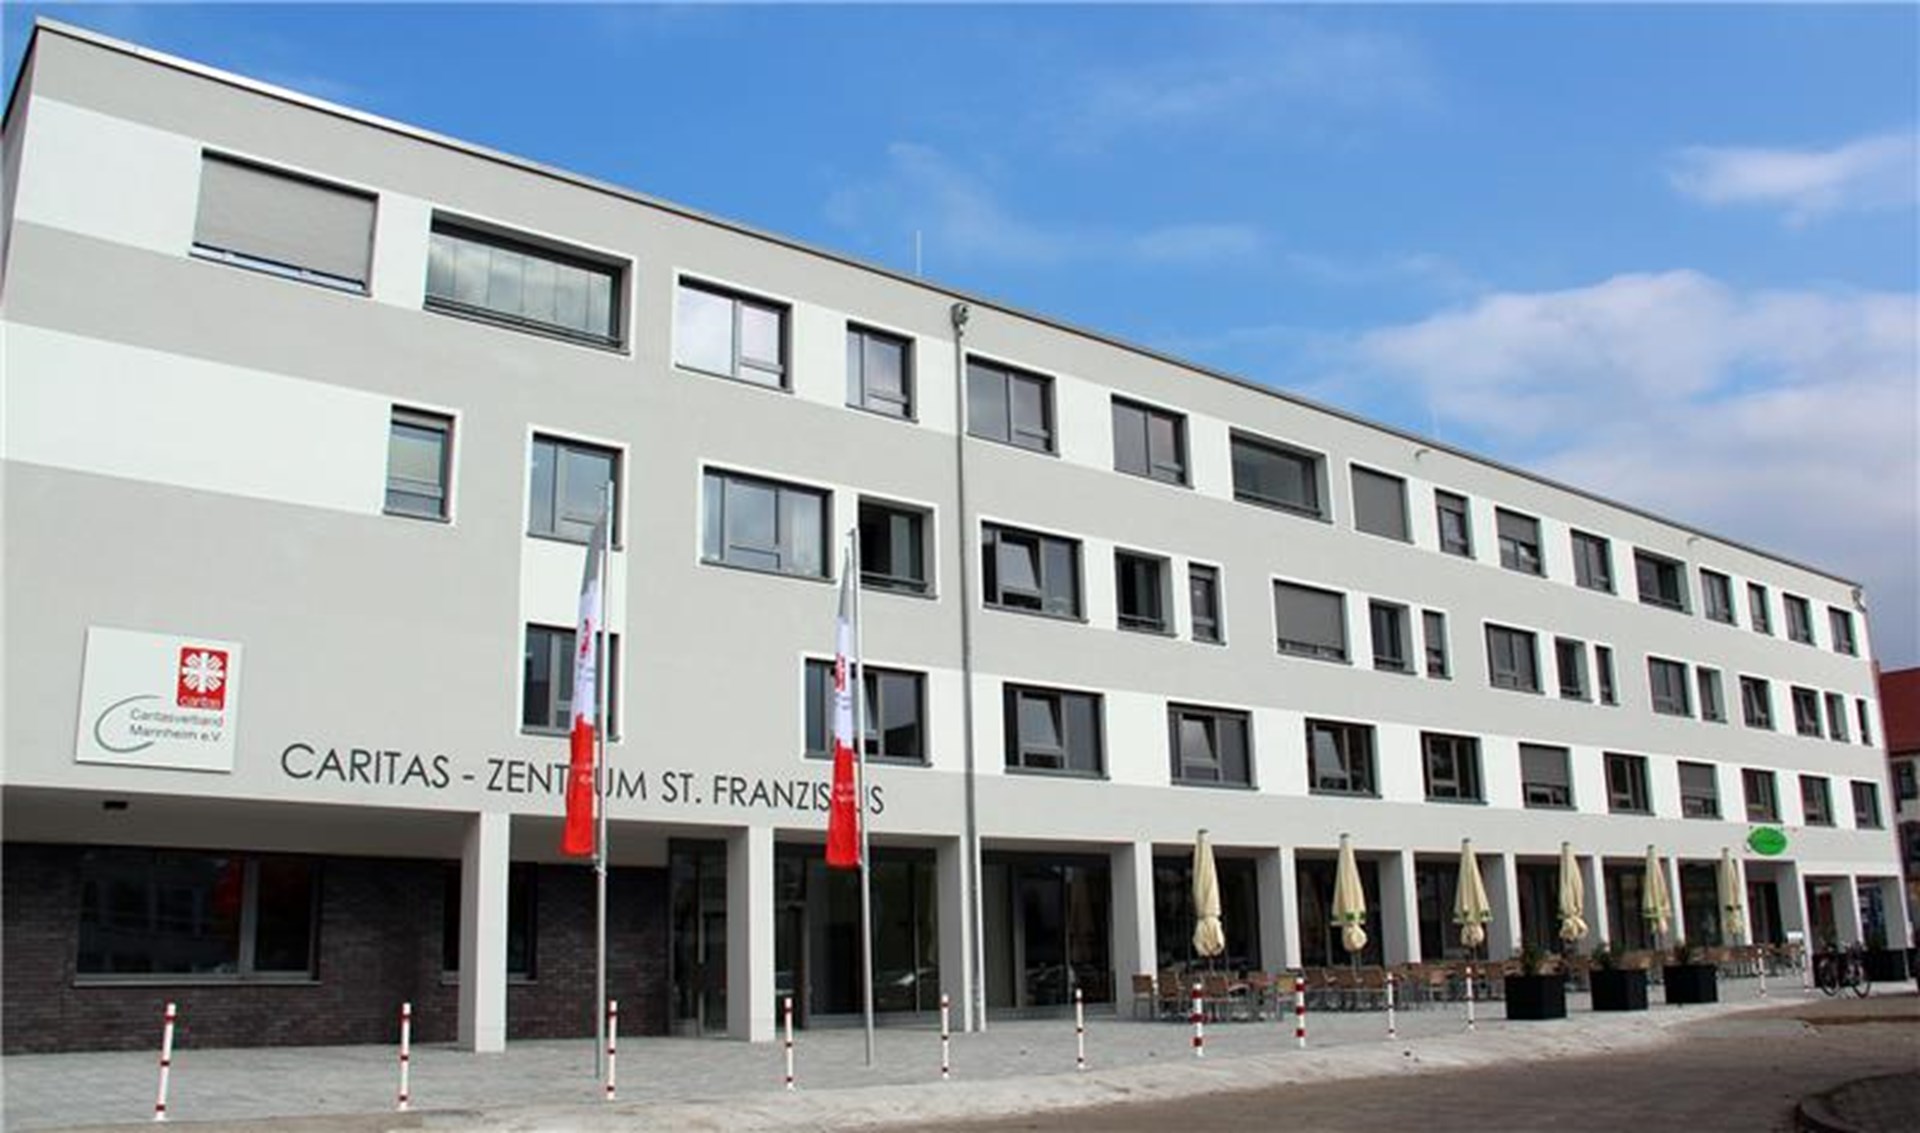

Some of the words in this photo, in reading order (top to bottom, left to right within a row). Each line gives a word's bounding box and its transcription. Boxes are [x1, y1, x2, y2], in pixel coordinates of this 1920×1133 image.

[130, 707, 224, 727] Caritasverband
[129, 724, 198, 740] Mannheim
[281, 743, 450, 788] CARITAS
[486, 758, 647, 800] ZENTUM
[662, 771, 702, 804] ST.
[713, 775, 884, 815] FRANZISS
